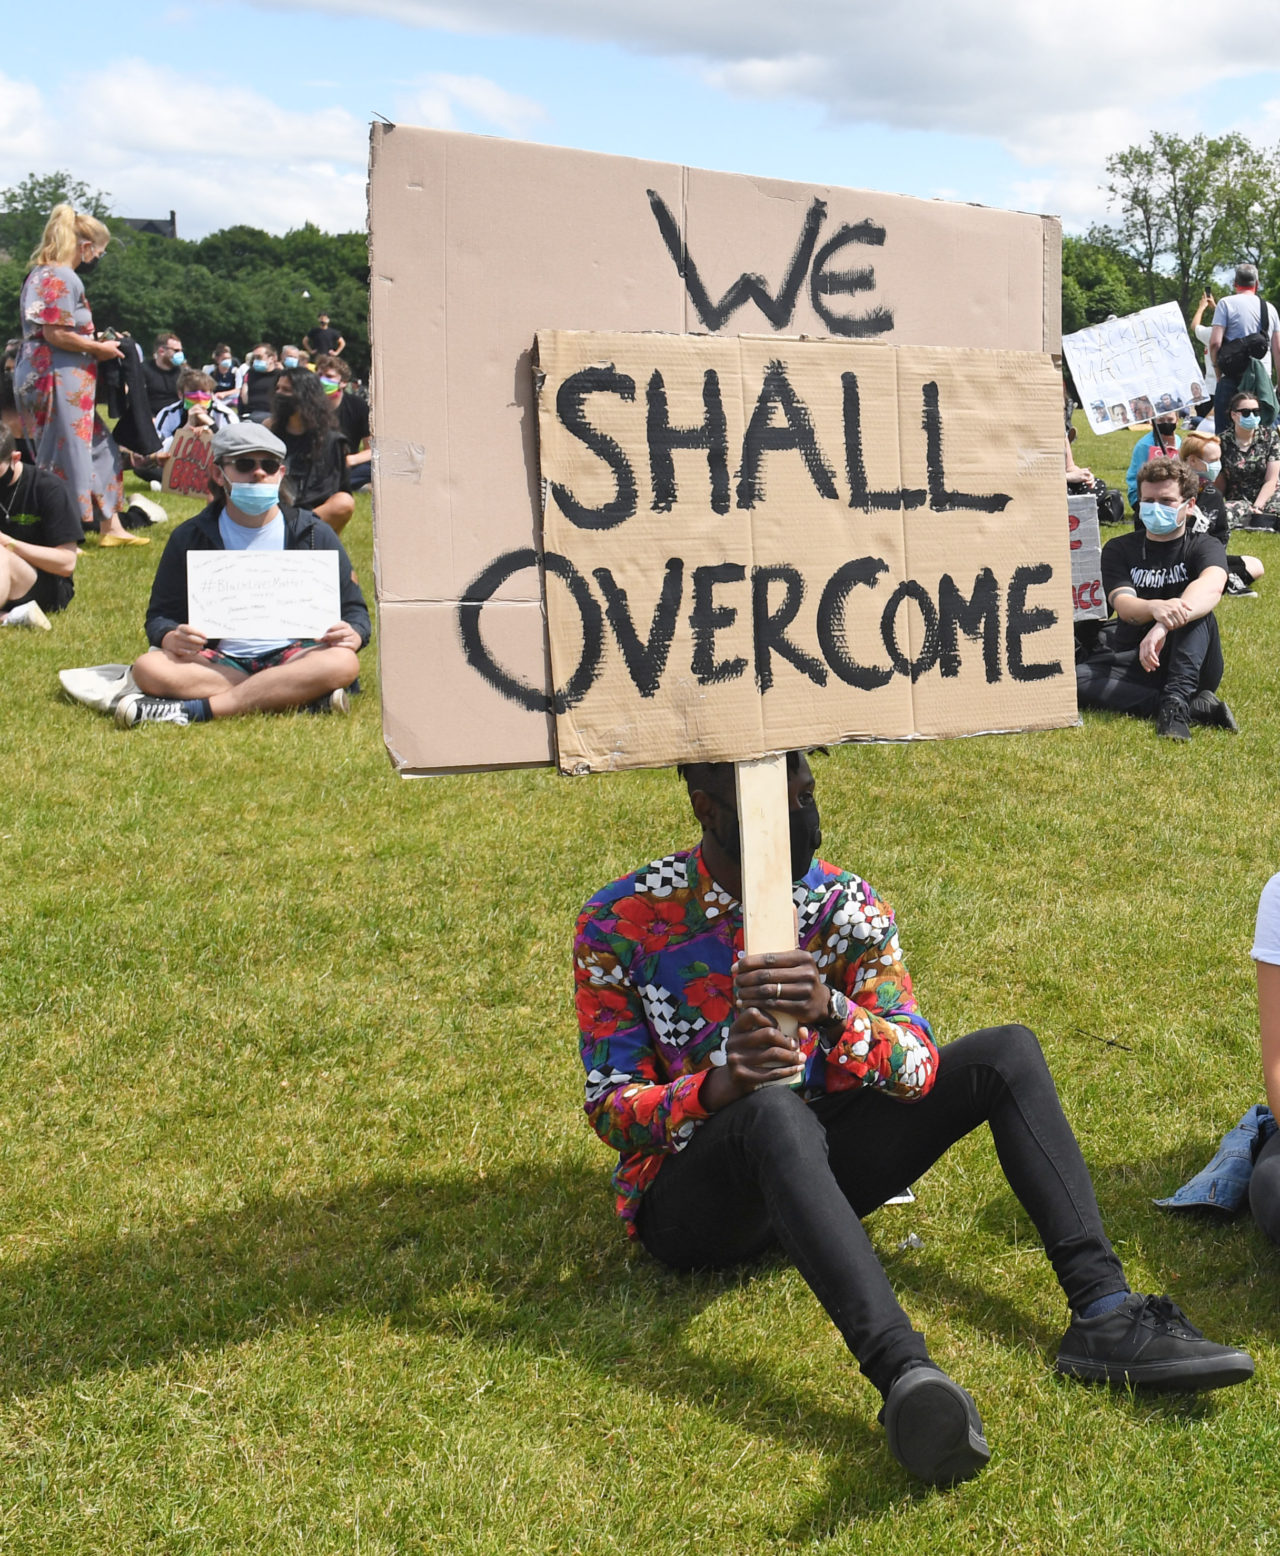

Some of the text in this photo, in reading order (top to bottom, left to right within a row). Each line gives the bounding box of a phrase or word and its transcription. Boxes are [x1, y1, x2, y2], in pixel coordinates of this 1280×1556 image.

[646, 187, 895, 335] WE
[548, 358, 1013, 532] SHALL
[457, 547, 1063, 715] OVERCOME
